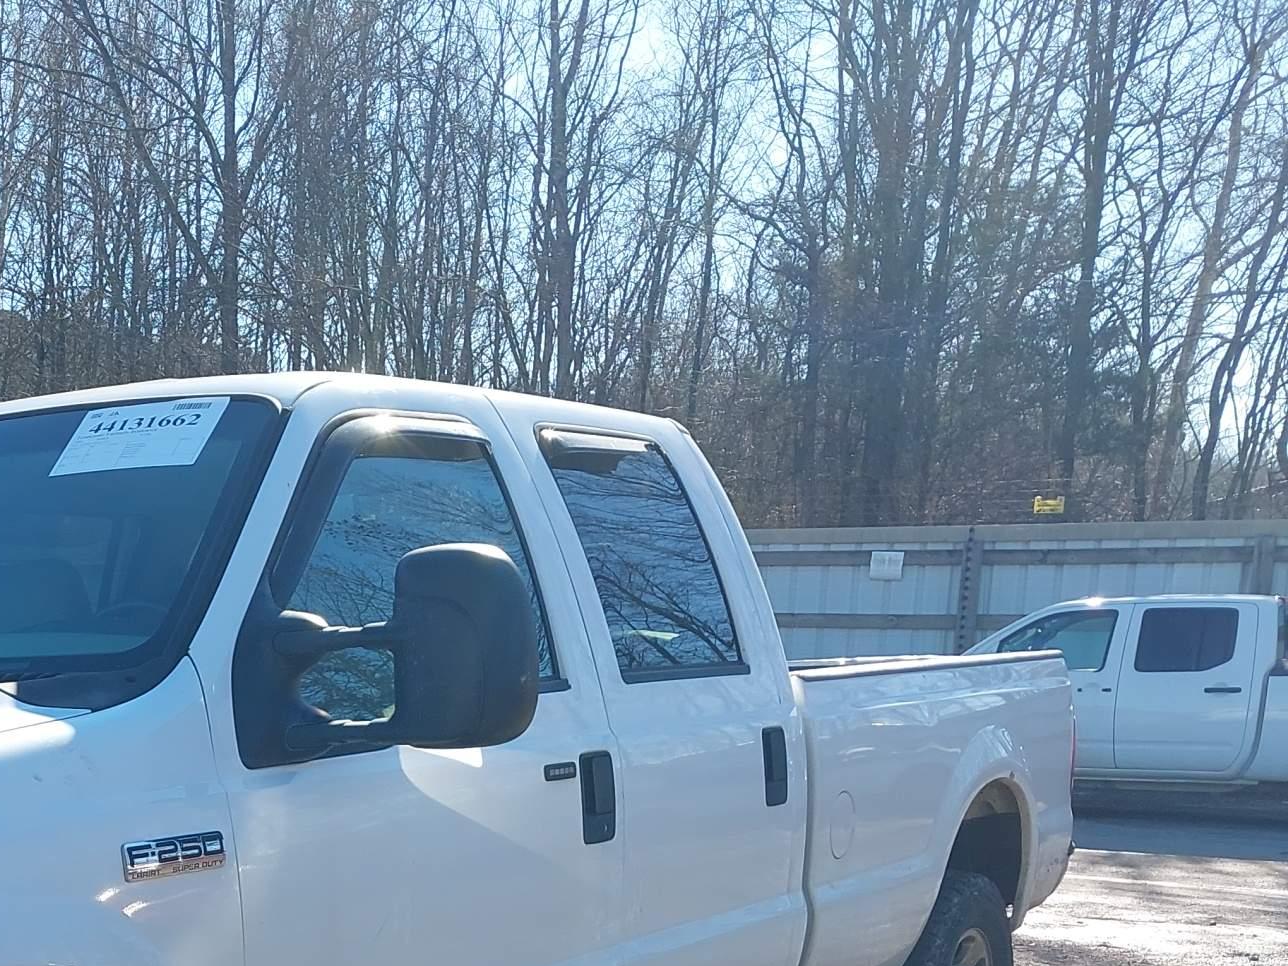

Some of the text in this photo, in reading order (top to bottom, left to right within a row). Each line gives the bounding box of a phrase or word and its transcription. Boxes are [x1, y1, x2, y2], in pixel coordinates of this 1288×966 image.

[88, 413, 202, 434] 44131662
[126, 834, 224, 868] F-250
[131, 859, 224, 880] LARIAT SUPER DUTY
